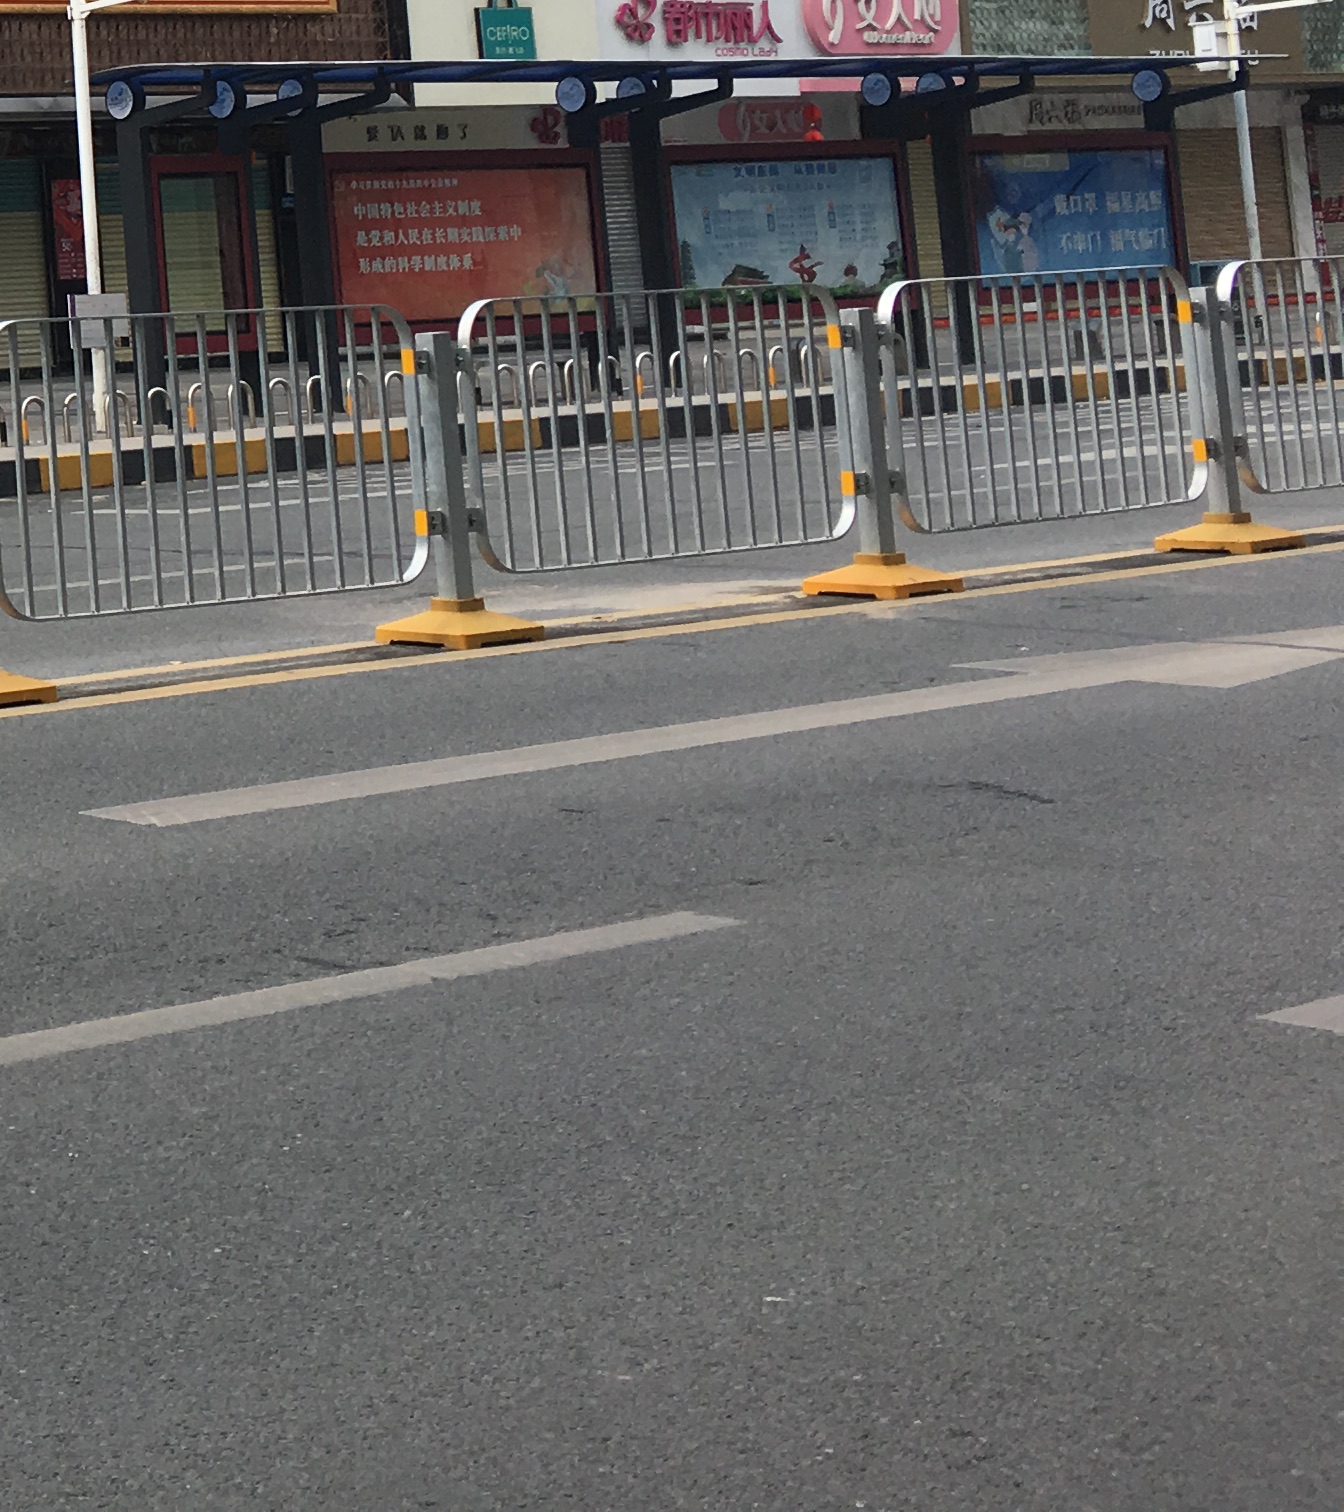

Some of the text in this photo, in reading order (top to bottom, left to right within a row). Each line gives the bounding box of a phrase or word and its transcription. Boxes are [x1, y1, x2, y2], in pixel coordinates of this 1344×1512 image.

[662, 0, 784, 44] 都市丽人
[354, 199, 482, 220] 中国特色社会主义制度
[356, 224, 522, 247] 是党和人民在长期实践探索中
[358, 252, 475, 274] 形成的科学制度体系
